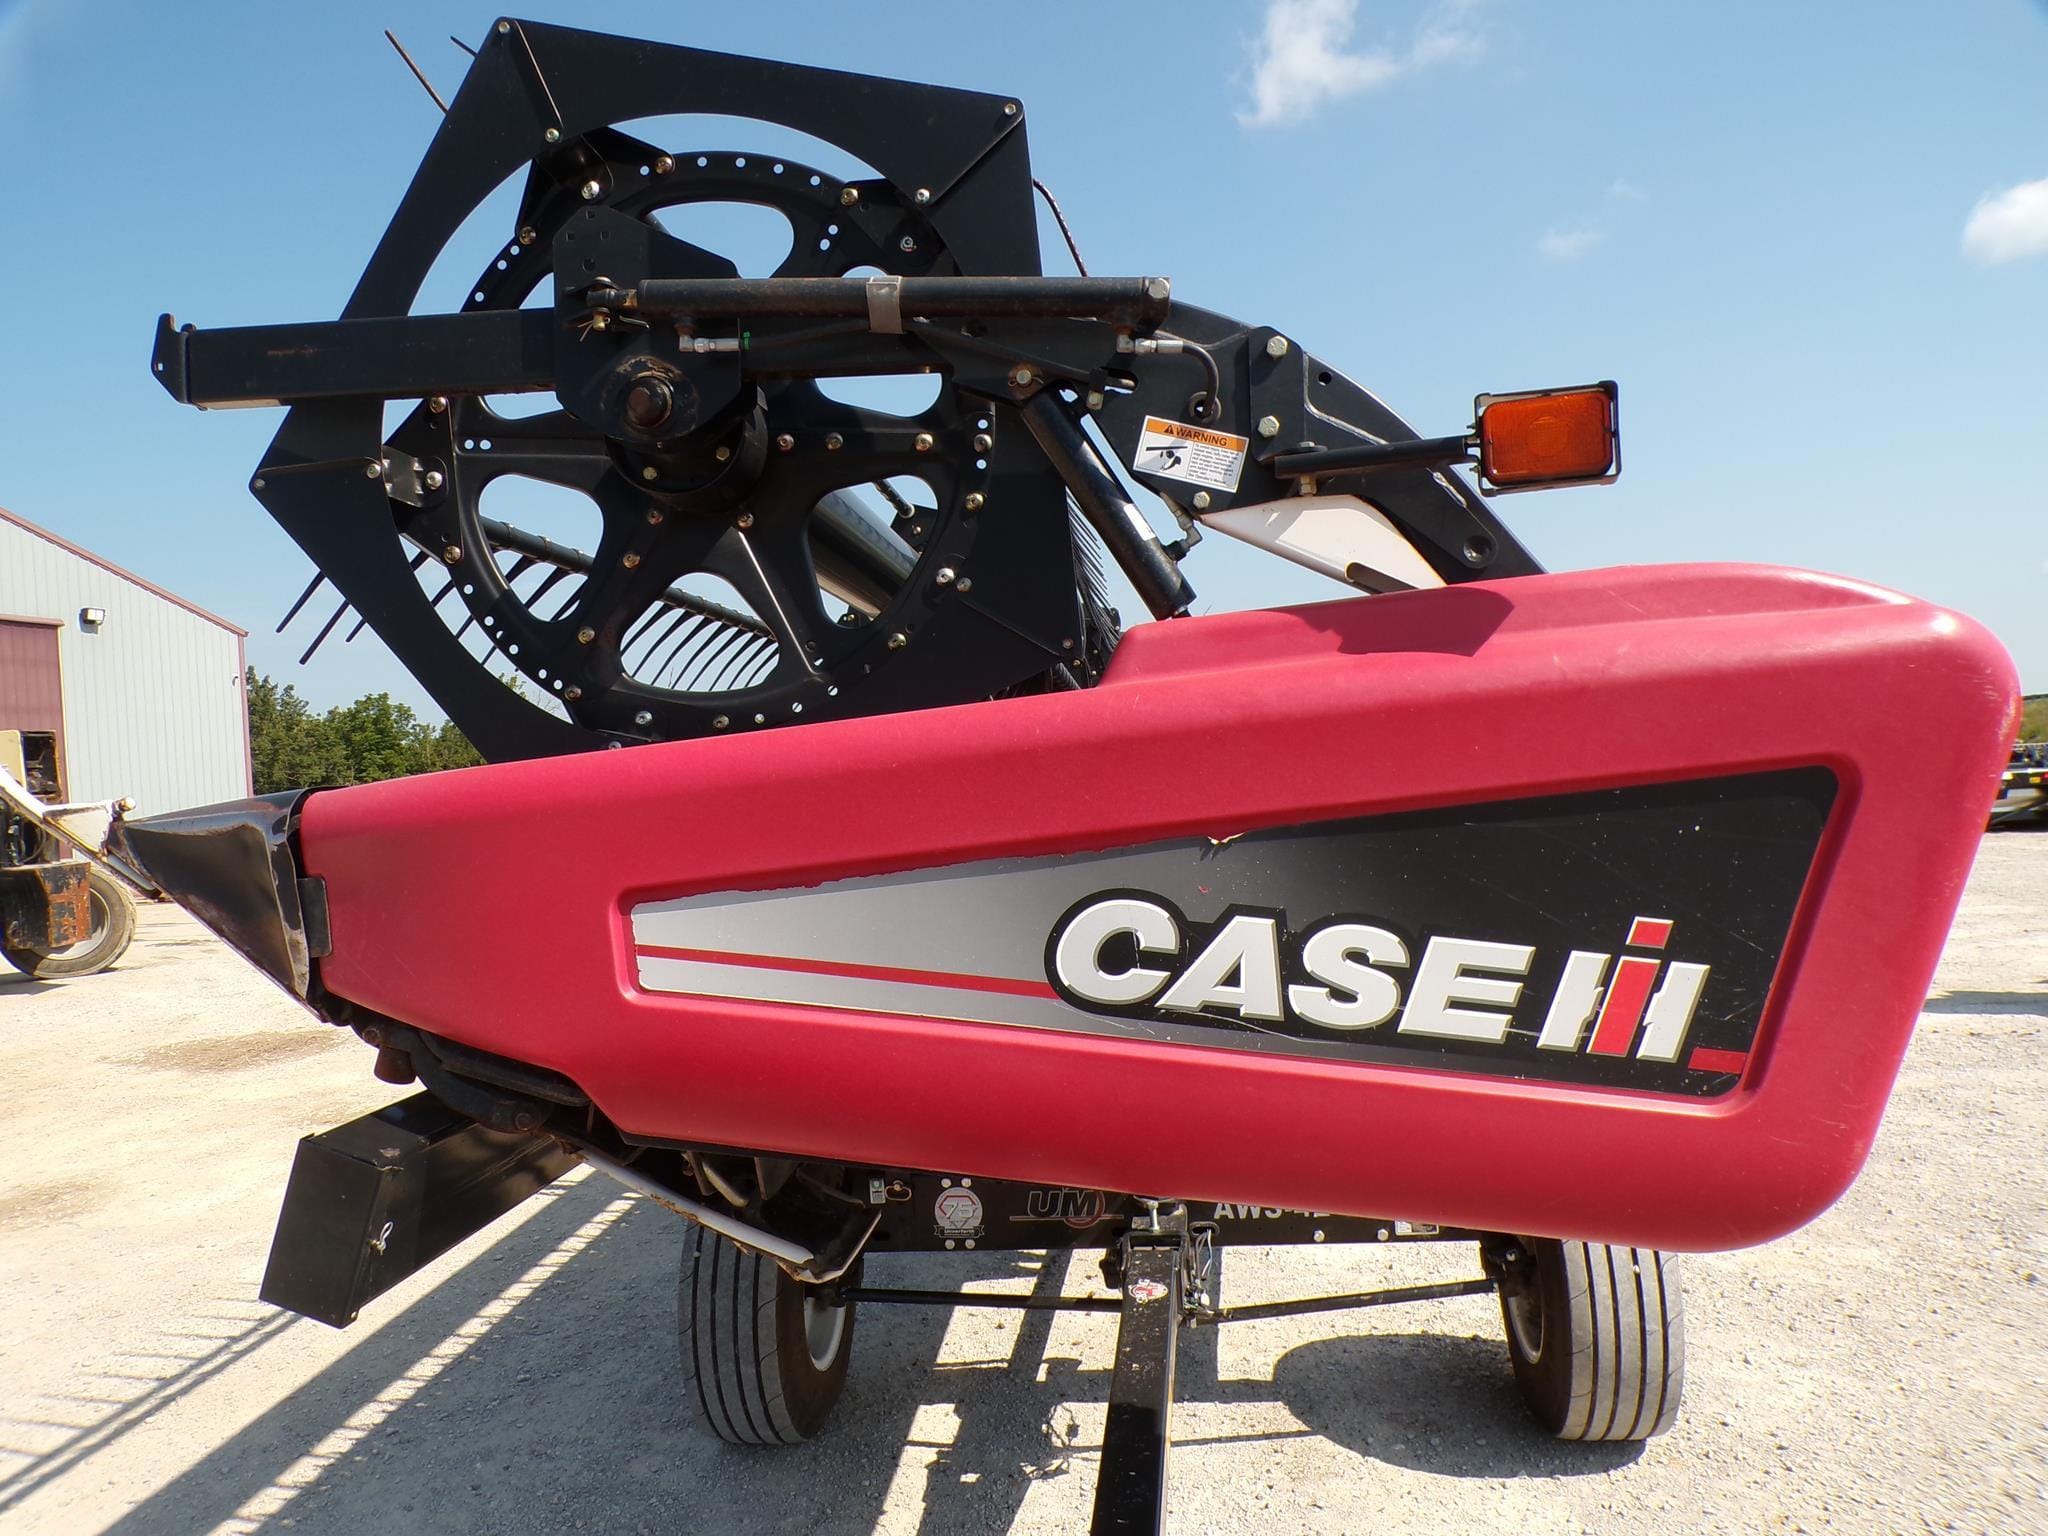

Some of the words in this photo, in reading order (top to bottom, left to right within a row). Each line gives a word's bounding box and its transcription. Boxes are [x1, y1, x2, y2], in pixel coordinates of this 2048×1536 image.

[1176, 427, 1227, 446] WARNING
[1056, 899, 1536, 1044] CASE
[1028, 1189, 1100, 1217] UM
